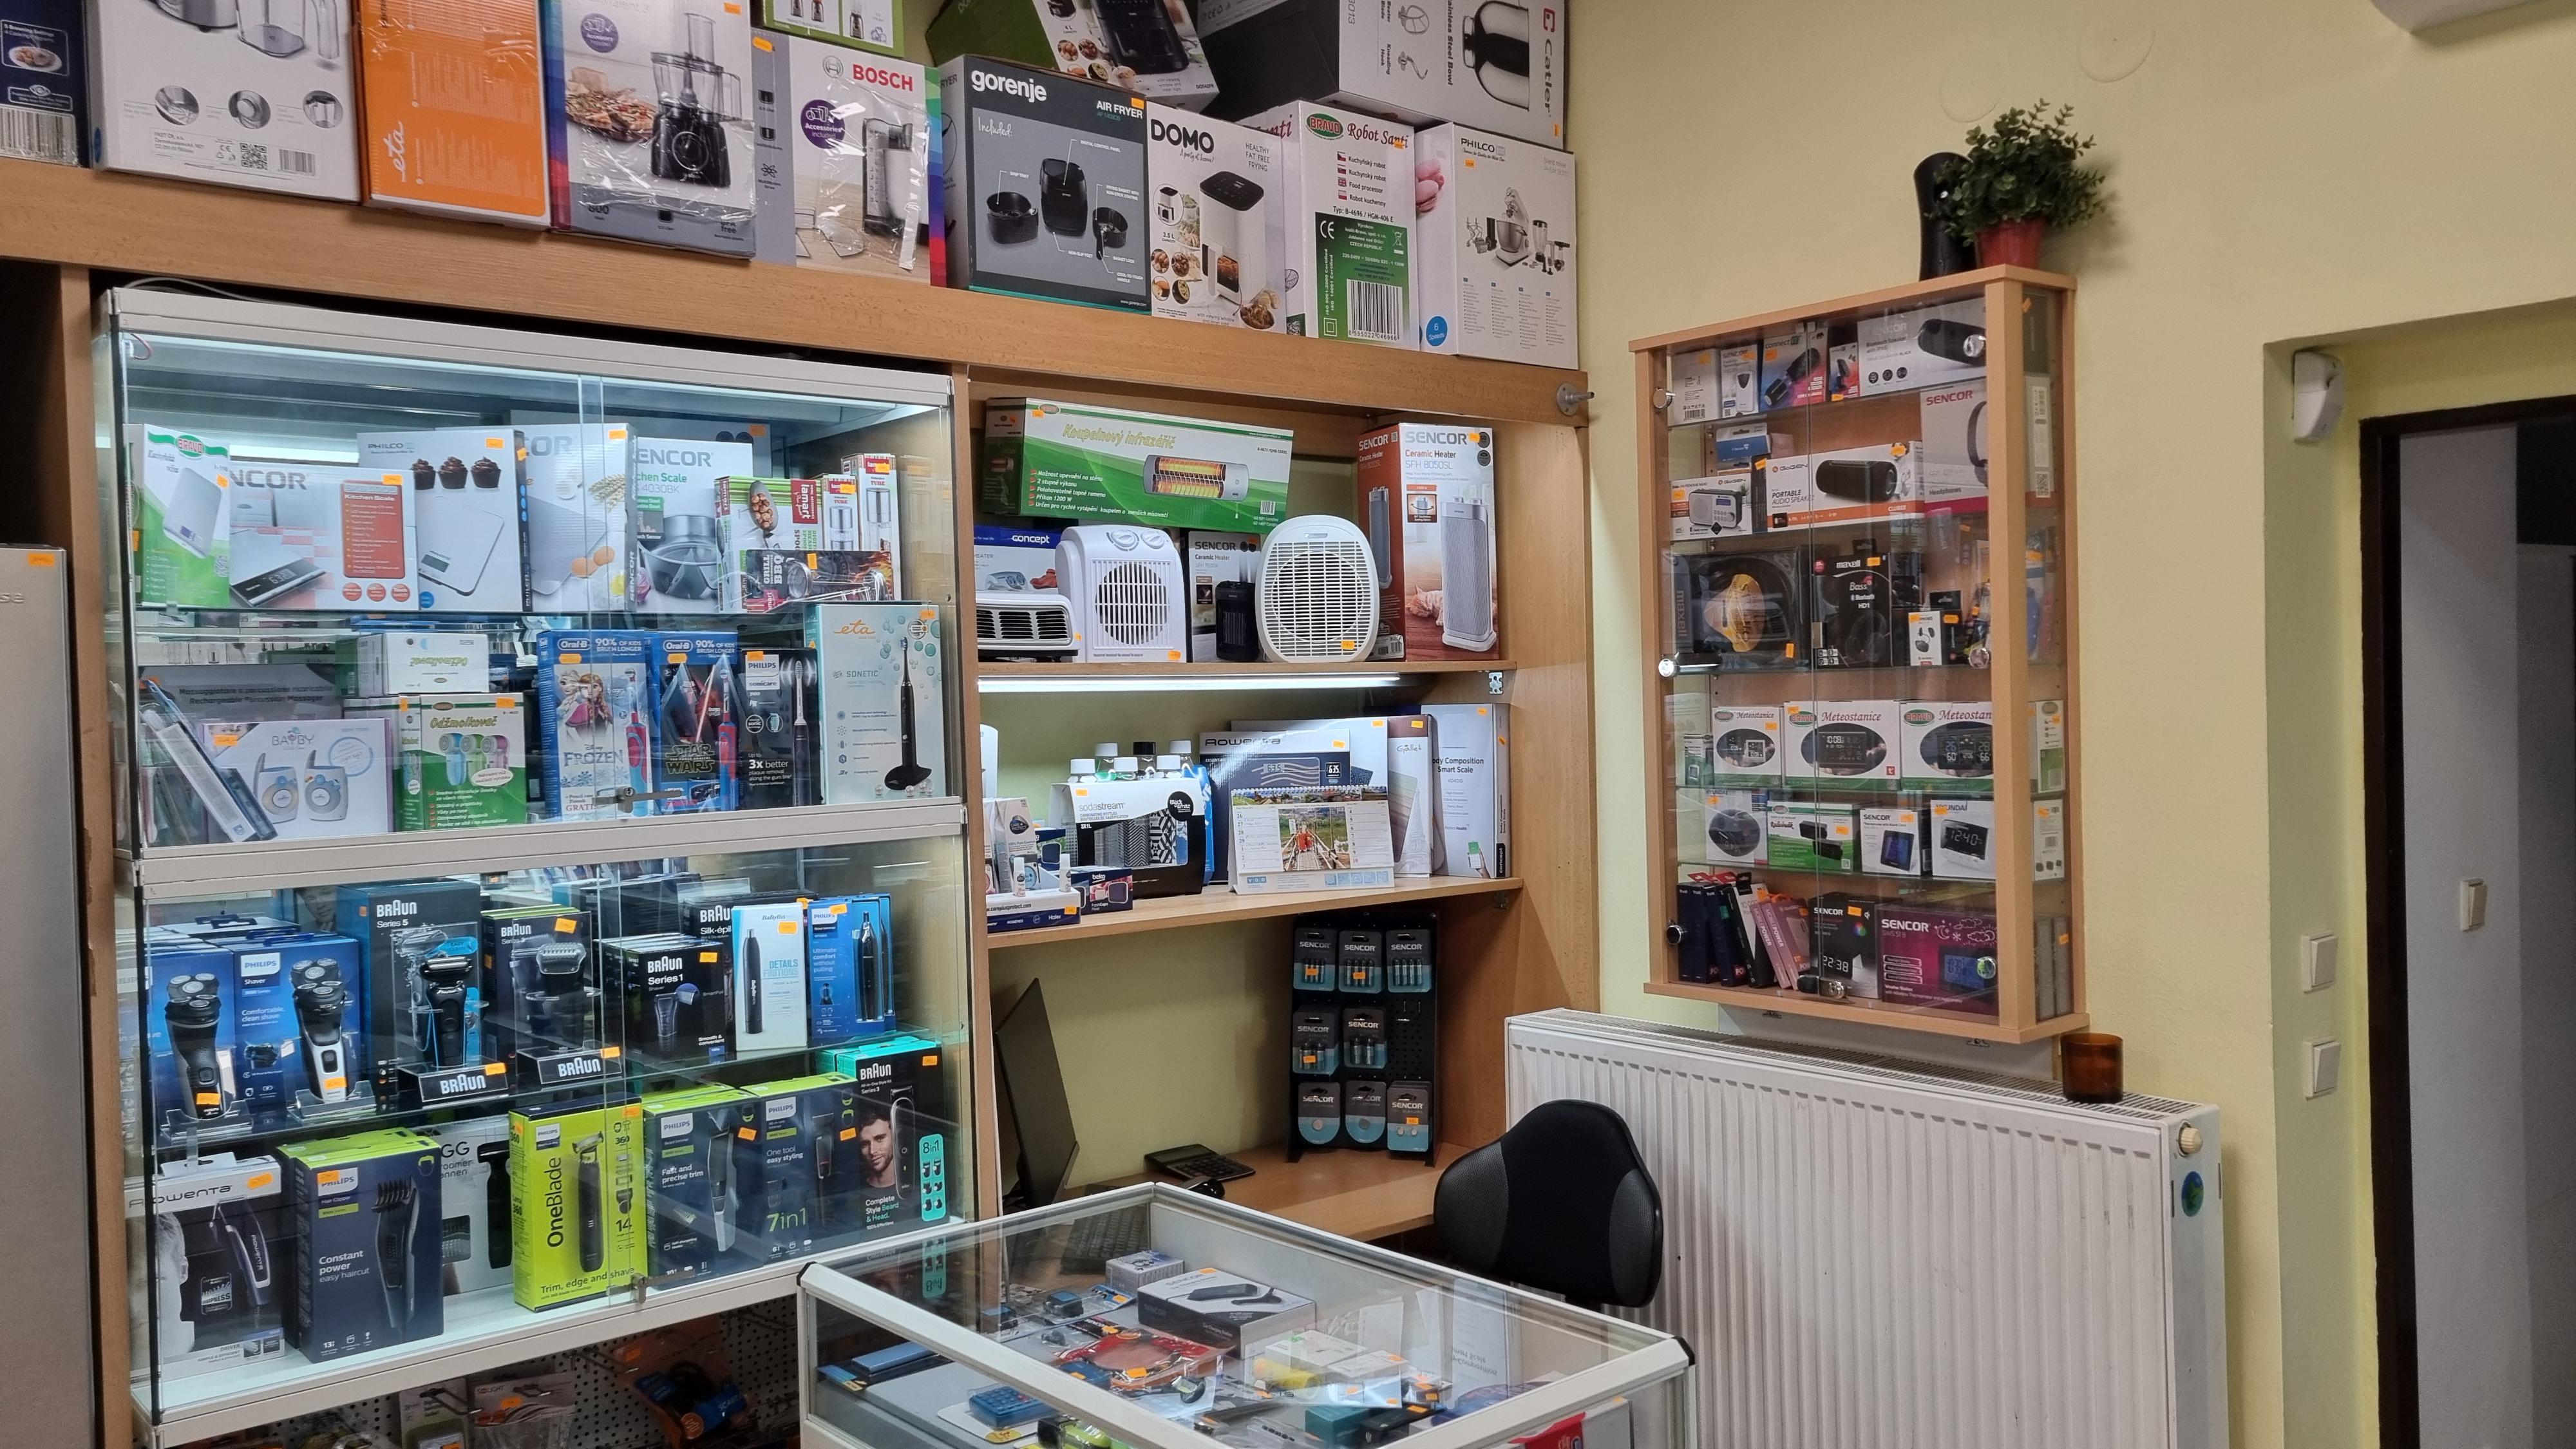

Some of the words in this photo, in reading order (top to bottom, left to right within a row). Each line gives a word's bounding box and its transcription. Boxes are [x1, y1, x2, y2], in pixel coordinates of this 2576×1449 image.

[852, 64, 913, 91] BOSCH
[1544, 39, 1554, 115] Catler
[971, 70, 1047, 103] gorenje
[1096, 100, 1112, 113] AIR
[1113, 104, 1144, 120] FRYER
[805, 122, 844, 135] Accessories
[977, 116, 1014, 138] Included:
[1310, 117, 1341, 134] BRAVO
[1347, 122, 1380, 140] Robot
[811, 131, 837, 140] included
[1150, 119, 1215, 155] DOMO
[1245, 142, 1271, 155] HEALTHY
[1461, 137, 1495, 153] PHILCO
[381, 120, 408, 184] eta
[1245, 151, 1258, 161] FAT
[1258, 154, 1271, 164] FREE
[1248, 160, 1269, 173] FRYING
[1373, 161, 1386, 169] robot
[1373, 174, 1387, 182] robot
[1349, 181, 1361, 189] Food
[1361, 184, 1384, 194] processor
[1349, 194, 1363, 202] Robot
[1363, 196, 1387, 208] kuchenny
[1765, 339, 1790, 350] connect
[1926, 390, 1974, 406] SENCOR
[1063, 424, 1124, 447] Koupelnový
[1124, 430, 1177, 450] infrazářič
[1359, 435, 1388, 451] SENCOR
[1405, 431, 1468, 445] SENCOR
[177, 438, 204, 455] BRAVO
[637, 449, 712, 467] ENCOR
[1405, 450, 1433, 458] Ceramic
[1434, 450, 1457, 459] Heater
[1405, 460, 1422, 469] SFH
[1423, 460, 1453, 469] 8050SL
[1779, 463, 1808, 471] GoGEN
[661, 473, 688, 483] Scale
[1772, 489, 1802, 498] PORTABLE
[1929, 487, 1962, 495] Headphones
[800, 484, 811, 519] lamart
[1772, 497, 1790, 505] AUDIO
[1012, 534, 1050, 545] concept
[1195, 541, 1236, 551] SENCOR
[773, 554, 784, 585] BBQ
[1836, 559, 1861, 569] maxell
[629, 551, 639, 602] SENCOR
[1676, 590, 1687, 637] maxell
[833, 619, 876, 634] eta
[560, 639, 589, 649] Oral-B
[595, 638, 617, 647] 90%
[666, 642, 690, 650] Oral-B
[696, 639, 715, 648] 90%
[748, 661, 777, 670] PHILIPS
[846, 670, 878, 678] SONETIC
[1736, 710, 1775, 720] Meteostanice
[1821, 710, 1882, 723] Meteostanice
[1938, 709, 1992, 721] Meteostan
[430, 715, 498, 729] Odžmolkovač
[271, 734, 315, 746] BAYBY
[665, 743, 715, 758] STAR
[1396, 744, 1422, 753] Gallet
[564, 750, 624, 768] FROZEN
[748, 759, 763, 769] 3x
[765, 759, 789, 768] better
[1444, 757, 1484, 766] Composition
[665, 760, 715, 775] WARS
[1079, 802, 1124, 812] sodastream
[1863, 813, 1891, 822] SENCOR
[1948, 830, 1979, 846] 12:40
[377, 899, 417, 917] BRAUN
[700, 905, 730, 922] BRAU
[1814, 907, 1844, 916] SENCOR
[377, 920, 401, 928] Series
[500, 923, 531, 937] BRAUN
[1881, 919, 1929, 933] SENCOR
[1761, 925, 1772, 947] POWER
[1772, 925, 1784, 948] POWER
[1299, 941, 1331, 949] SENCOR
[1390, 943, 1423, 951] SENCOR
[244, 959, 277, 969] PHILIPS
[647, 956, 683, 973] BRAUN
[769, 958, 799, 969] DETAILS
[244, 977, 266, 985] Shaver
[648, 975, 677, 985] Series
[242, 1006, 285, 1016] Comfortable
[1348, 1021, 1379, 1029] SENCOR
[557, 1057, 601, 1077] BRAUN
[860, 1063, 891, 1080] BRAUN
[440, 1074, 487, 1095] BRAUN
[768, 1103, 794, 1114] PHILIPS
[1392, 1101, 1423, 1110] SENCOR
[664, 1121, 690, 1131] PHILIPS
[615, 1135, 630, 1144] 360
[766, 1148, 780, 1157] One
[782, 1146, 796, 1154] tool
[922, 1139, 940, 1154] 8in1
[766, 1156, 782, 1165] easy
[782, 1151, 804, 1162] styling
[661, 1167, 677, 1175] Fast
[677, 1164, 692, 1172] and
[321, 1176, 354, 1187] PHILIPS
[662, 1173, 687, 1184] precise
[544, 1157, 564, 1248] OneBlade
[866, 1195, 895, 1206] Complete
[866, 1206, 881, 1215] Style
[881, 1202, 899, 1211] Beard
[766, 1207, 807, 1232] 7in1
[872, 1212, 890, 1221] Head.
[615, 1218, 632, 1231] 14
[319, 1250, 364, 1265] Constant
[319, 1262, 352, 1275] power
[319, 1273, 340, 1283] easy
[340, 1267, 370, 1279] haircut
[540, 1283, 564, 1294] Trim,
[565, 1276, 589, 1289] edge
[590, 1273, 608, 1283] and
[609, 1267, 635, 1280] shave
[220, 1343, 241, 1352] DRIVER
